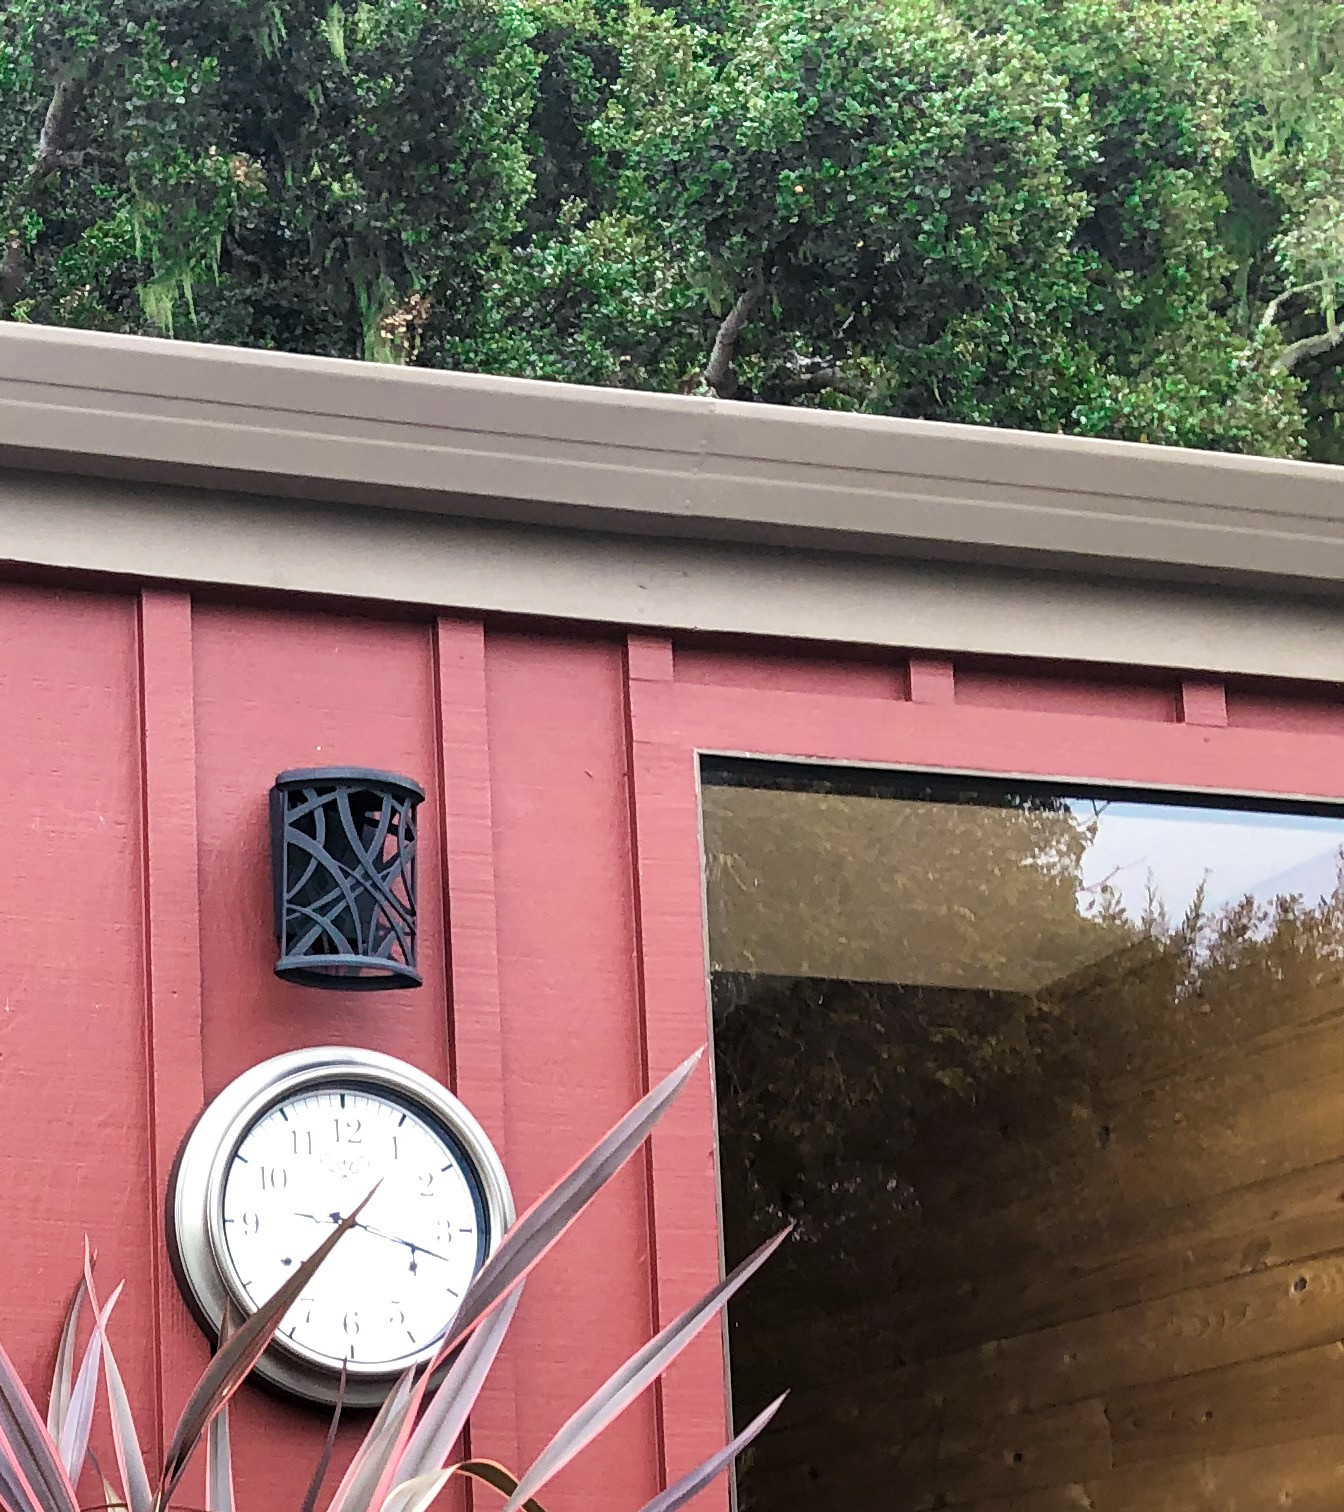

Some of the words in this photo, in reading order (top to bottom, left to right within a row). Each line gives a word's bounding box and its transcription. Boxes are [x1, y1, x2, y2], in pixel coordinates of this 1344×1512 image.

[292, 1129, 312, 1155] 11
[334, 1118, 362, 1143] 12
[391, 1135, 399, 1160] 1
[260, 1165, 288, 1190] 10
[418, 1172, 435, 1197] 2
[242, 1211, 260, 1236] 9
[436, 1219, 453, 1243] 3
[343, 1311, 360, 1334] 6
